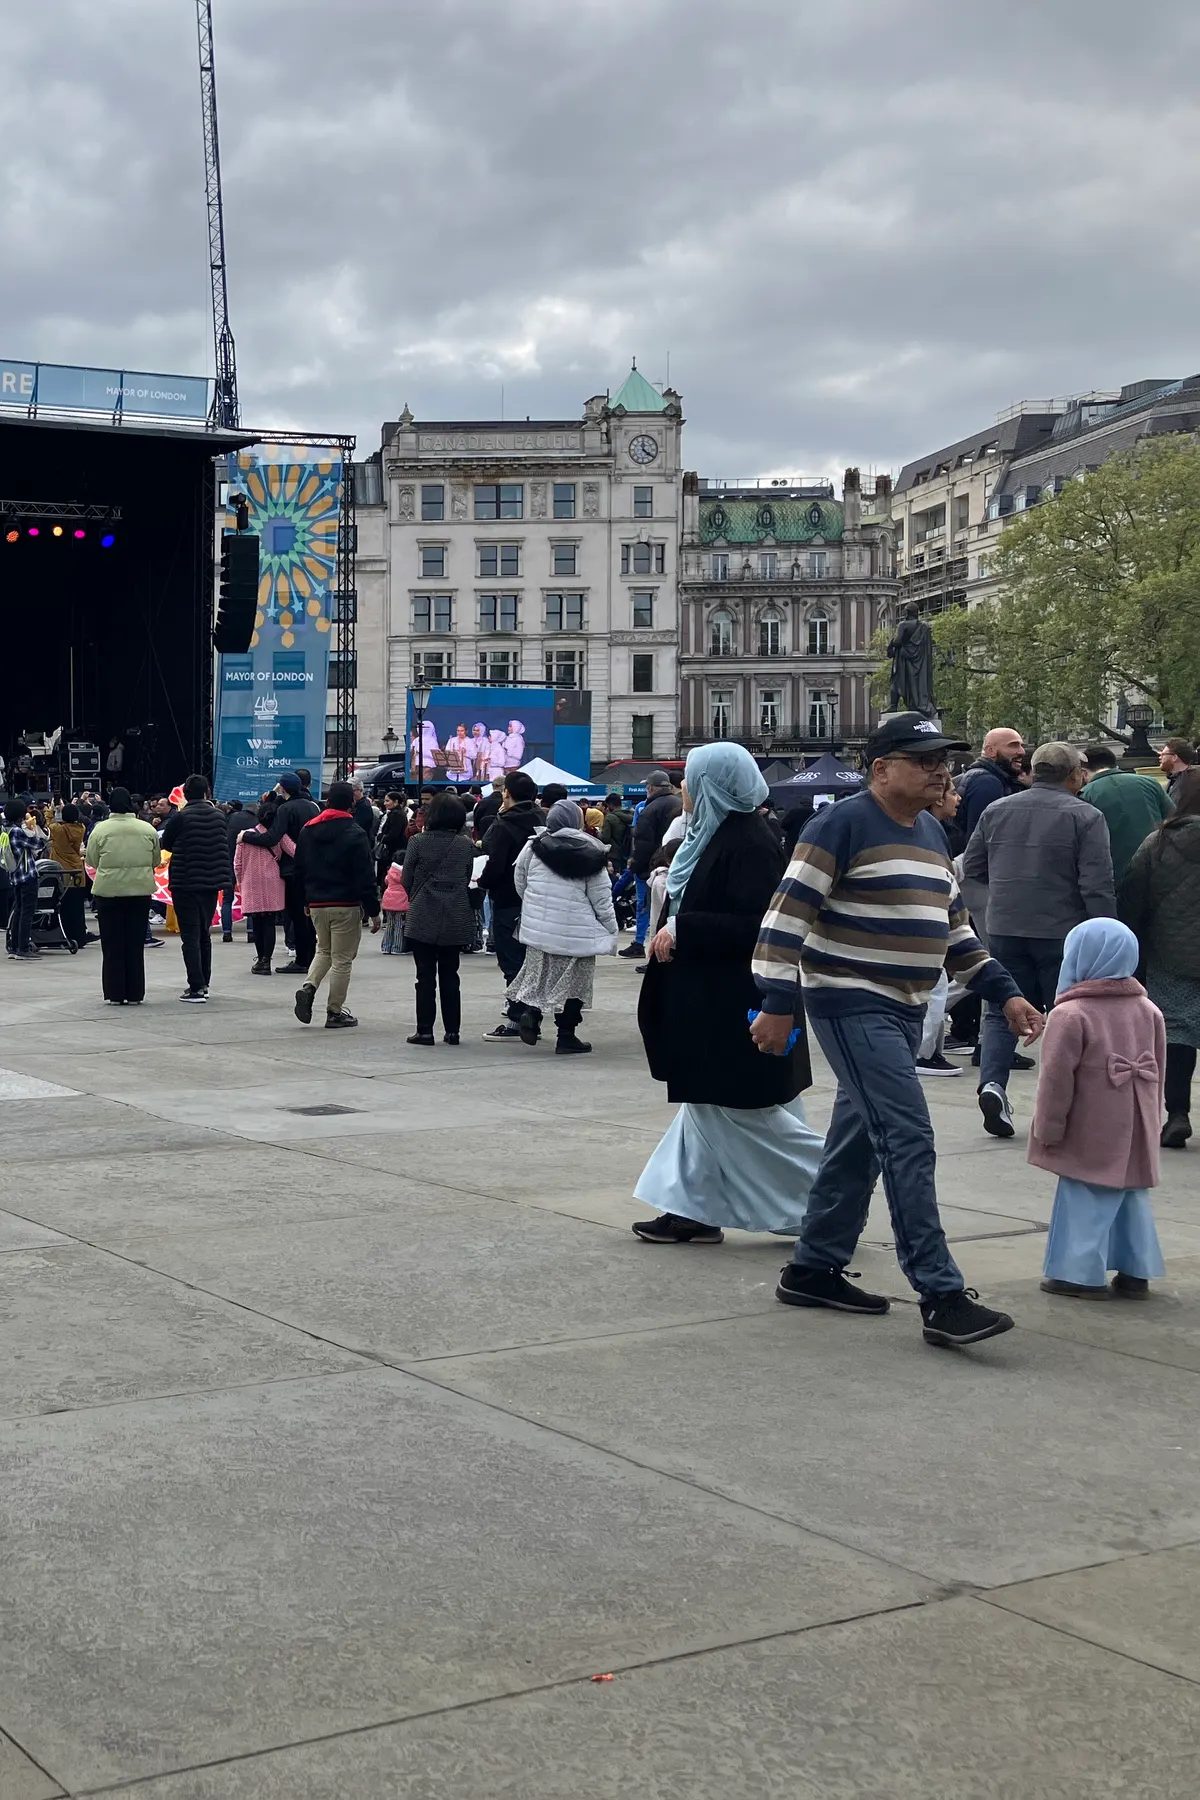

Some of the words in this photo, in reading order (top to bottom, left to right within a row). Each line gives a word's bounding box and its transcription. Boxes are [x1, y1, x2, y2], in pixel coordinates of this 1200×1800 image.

[106, 386, 135, 397] MAYOR
[137, 389, 149, 398] OF
[150, 390, 187, 401] LONDON
[225, 672, 255, 681] MAYOR
[257, 672, 270, 681] OF
[272, 672, 314, 681] LONDON
[236, 756, 259, 766] GBS
[268, 757, 291, 769] gedu
[793, 771, 821, 780] GBS
